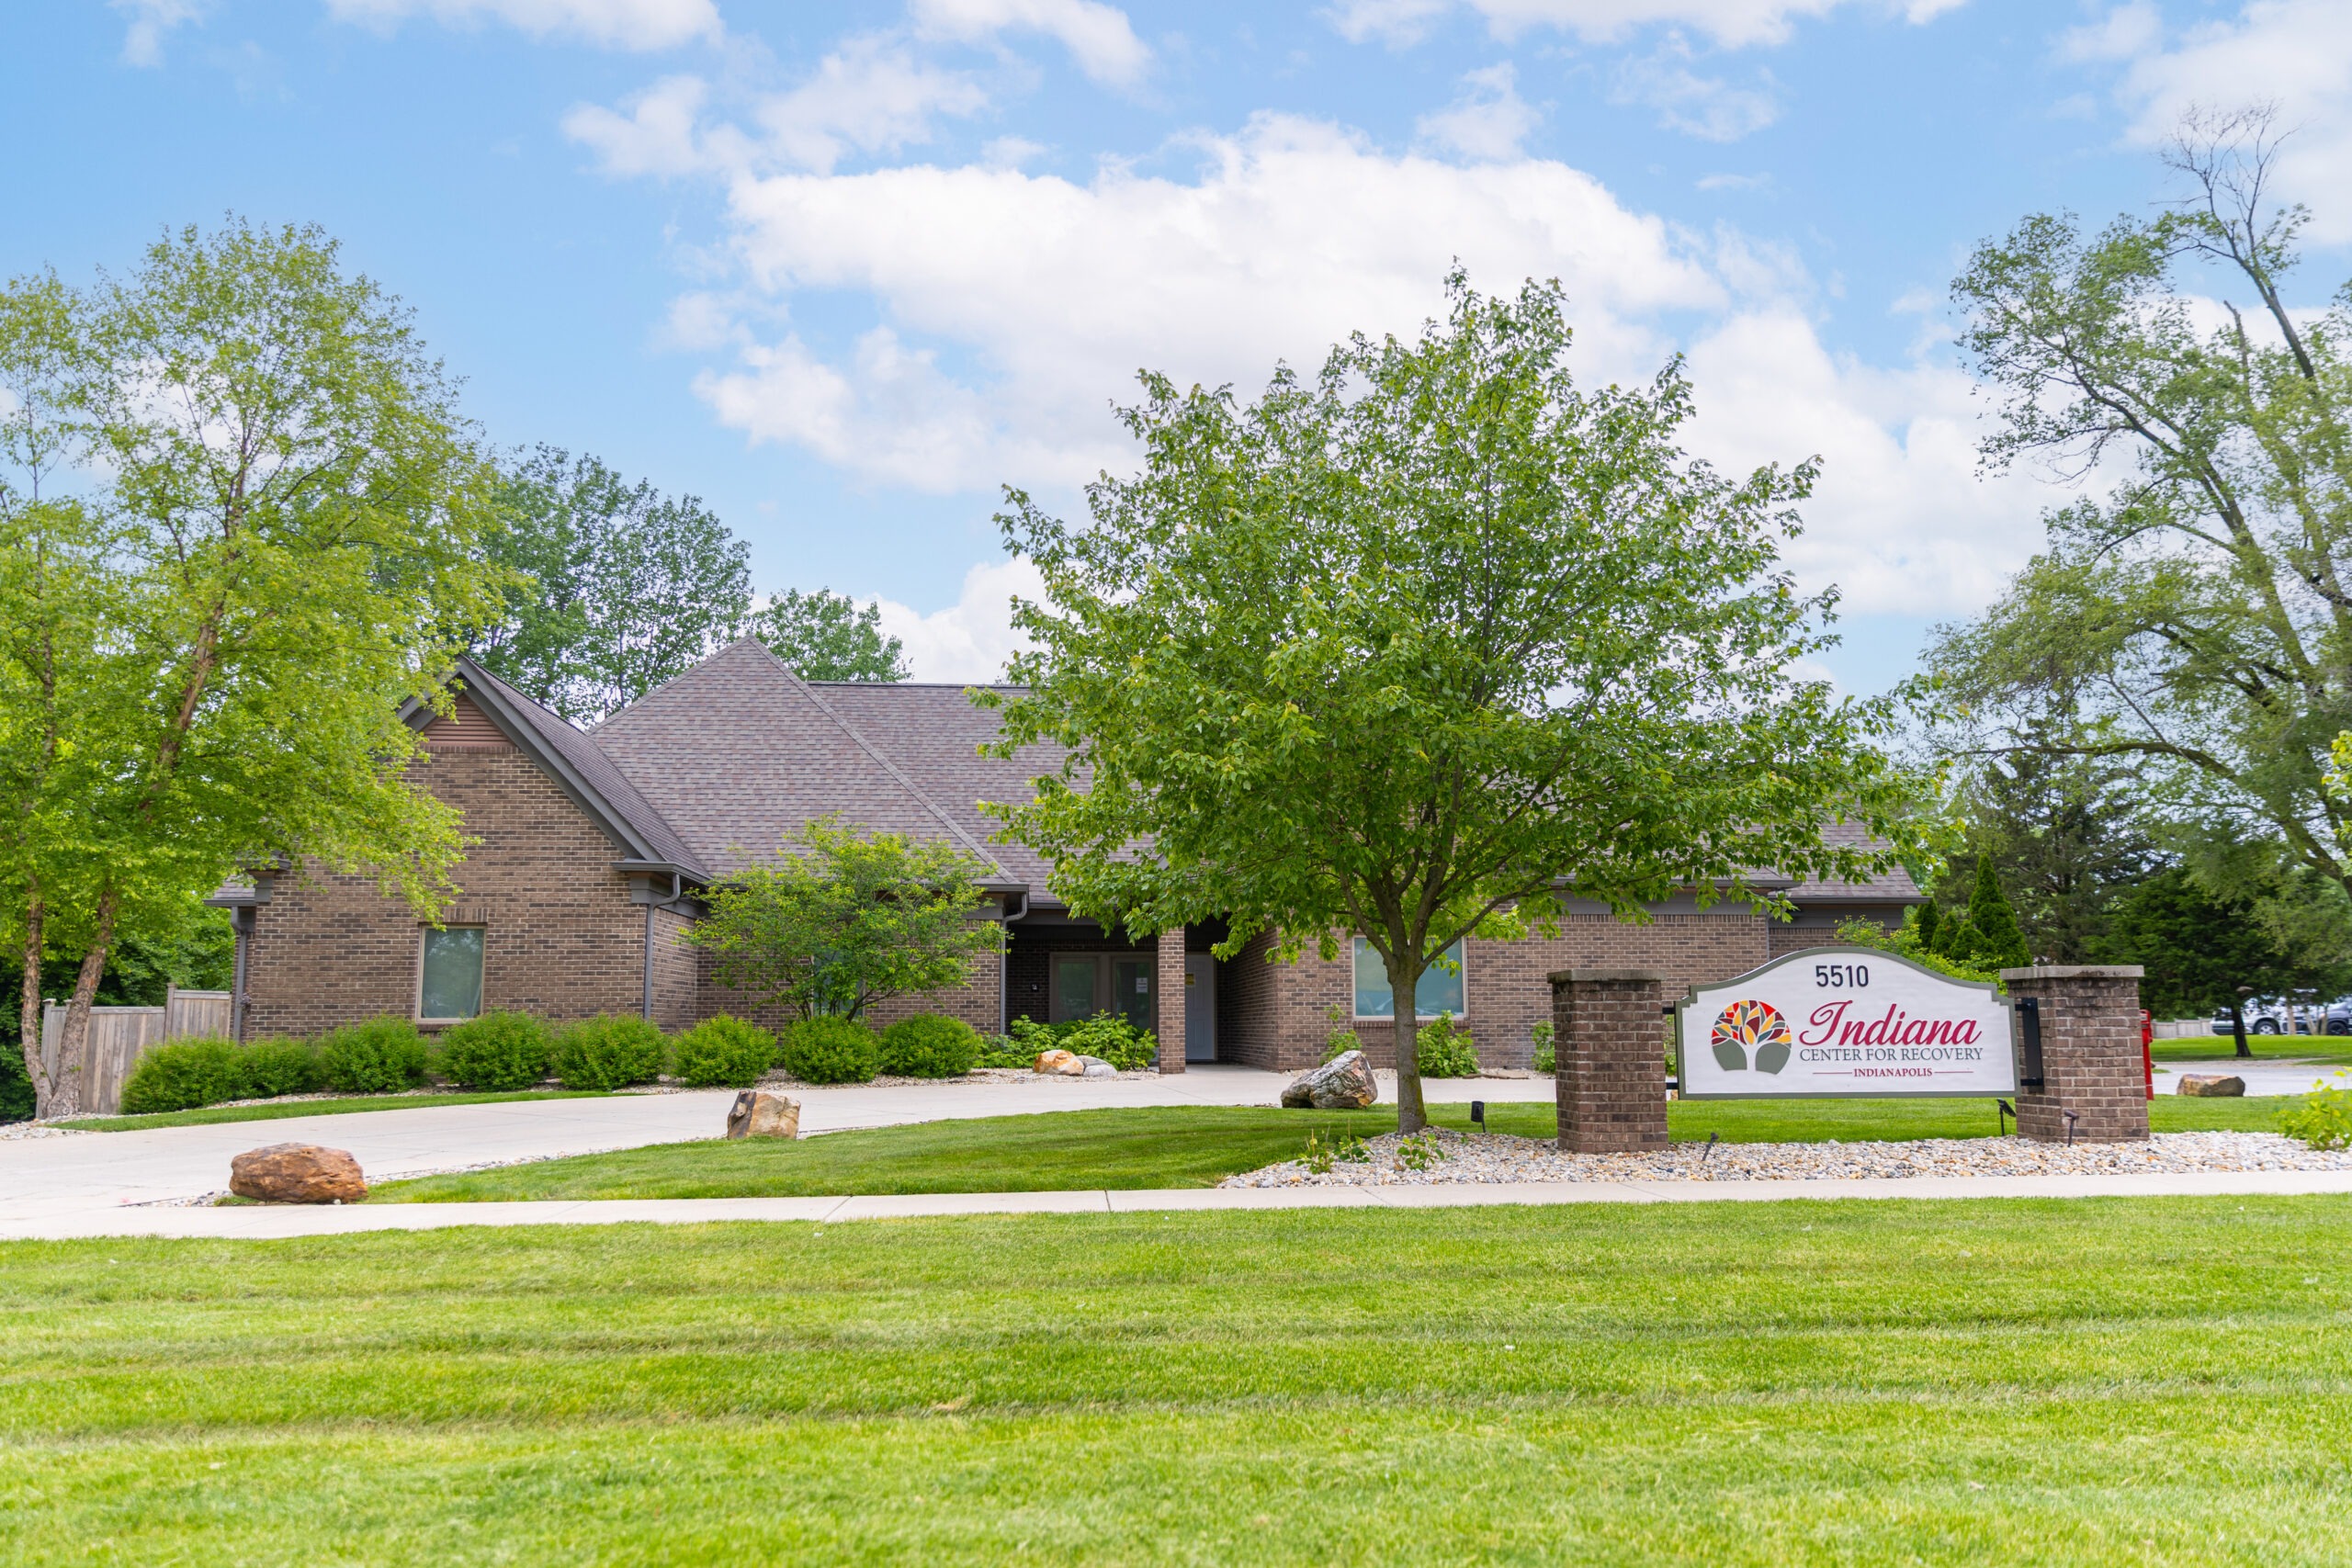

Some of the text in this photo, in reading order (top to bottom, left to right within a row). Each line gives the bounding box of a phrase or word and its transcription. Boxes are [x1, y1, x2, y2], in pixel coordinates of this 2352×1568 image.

[1815, 964, 1869, 987] 5510
[1799, 1000, 1982, 1045] Indiana
[1800, 1047, 1983, 1061] CENTER FOR RECOVERY
[1854, 1067, 1933, 1077] INDIANAPOLIS
